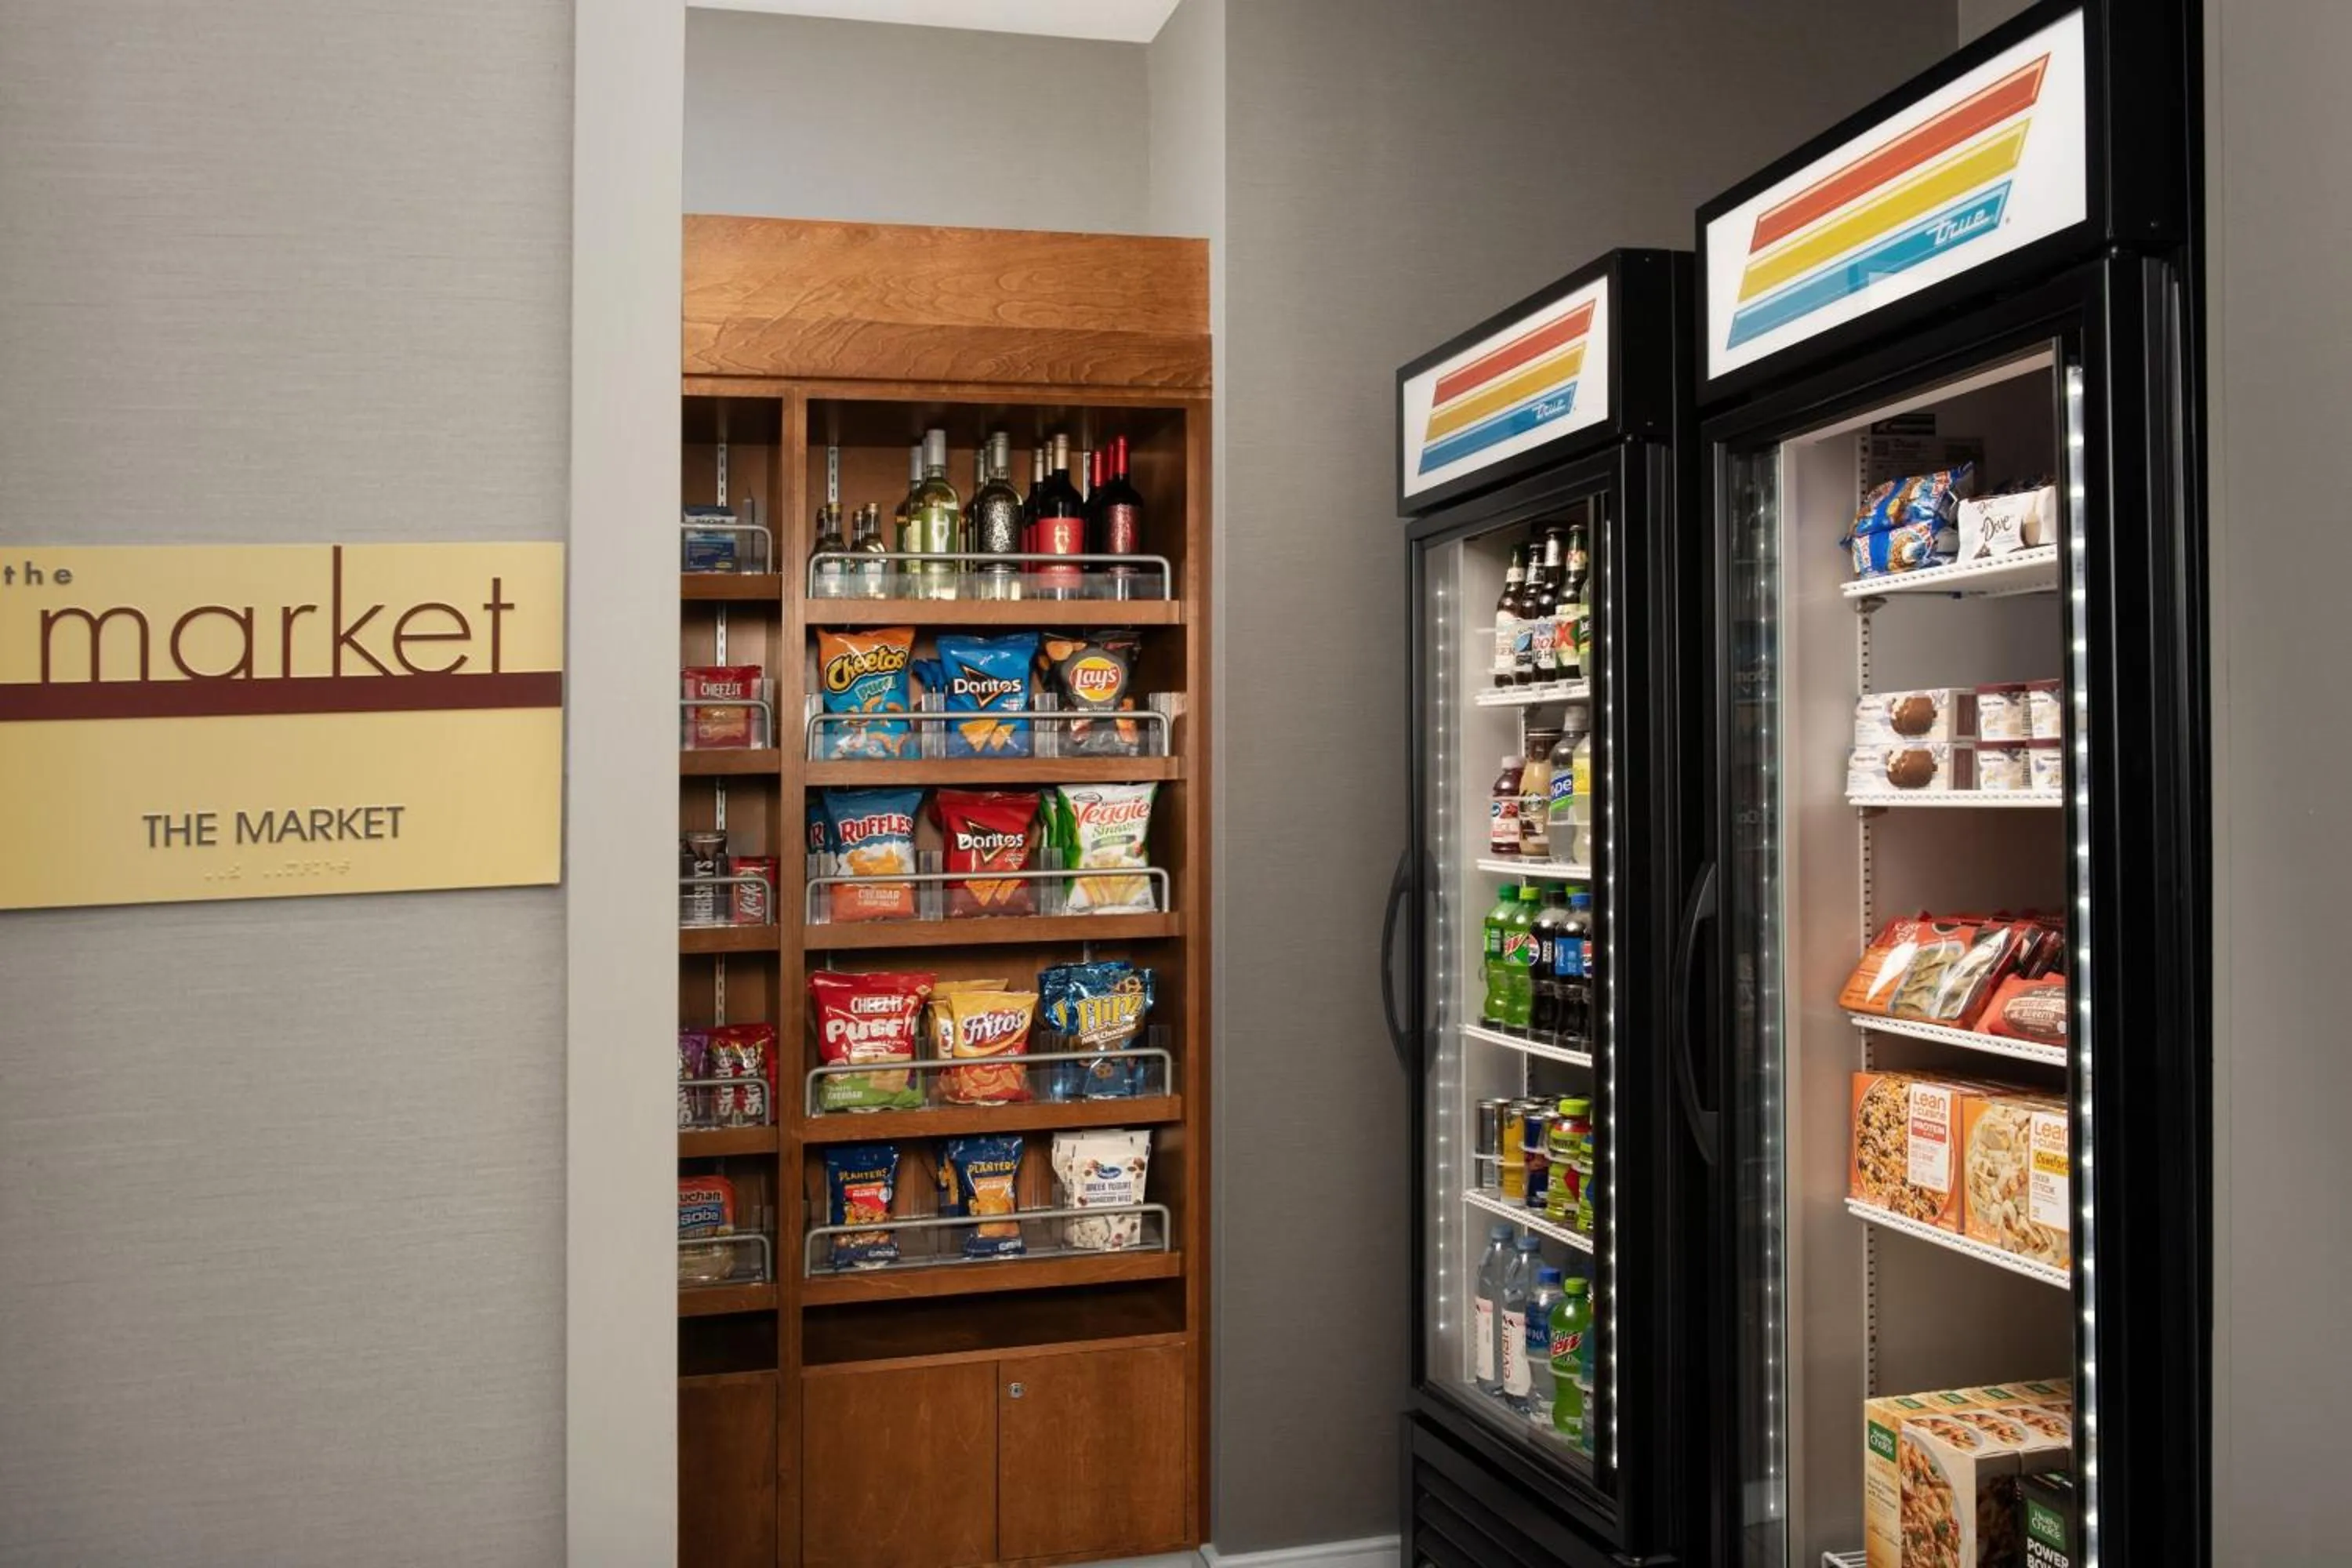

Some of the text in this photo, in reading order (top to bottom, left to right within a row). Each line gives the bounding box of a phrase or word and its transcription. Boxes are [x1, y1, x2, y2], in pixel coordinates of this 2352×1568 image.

[1926, 209, 1990, 245] True
[3, 561, 74, 586] the
[40, 545, 515, 683] market
[826, 644, 909, 693] Cheetos
[953, 677, 1023, 695] Doritos
[142, 805, 405, 848] THE MARKET
[838, 813, 914, 845] RUFFLES
[1072, 799, 1151, 829] Veggie
[956, 833, 1025, 851] Doritos
[694, 860, 714, 920] HERSHY'S
[962, 1010, 1028, 1045] Fritos
[1913, 1091, 1947, 1110] Lean
[838, 1167, 888, 1181] PLANTERS
[2027, 1536, 2069, 1568] POWER
